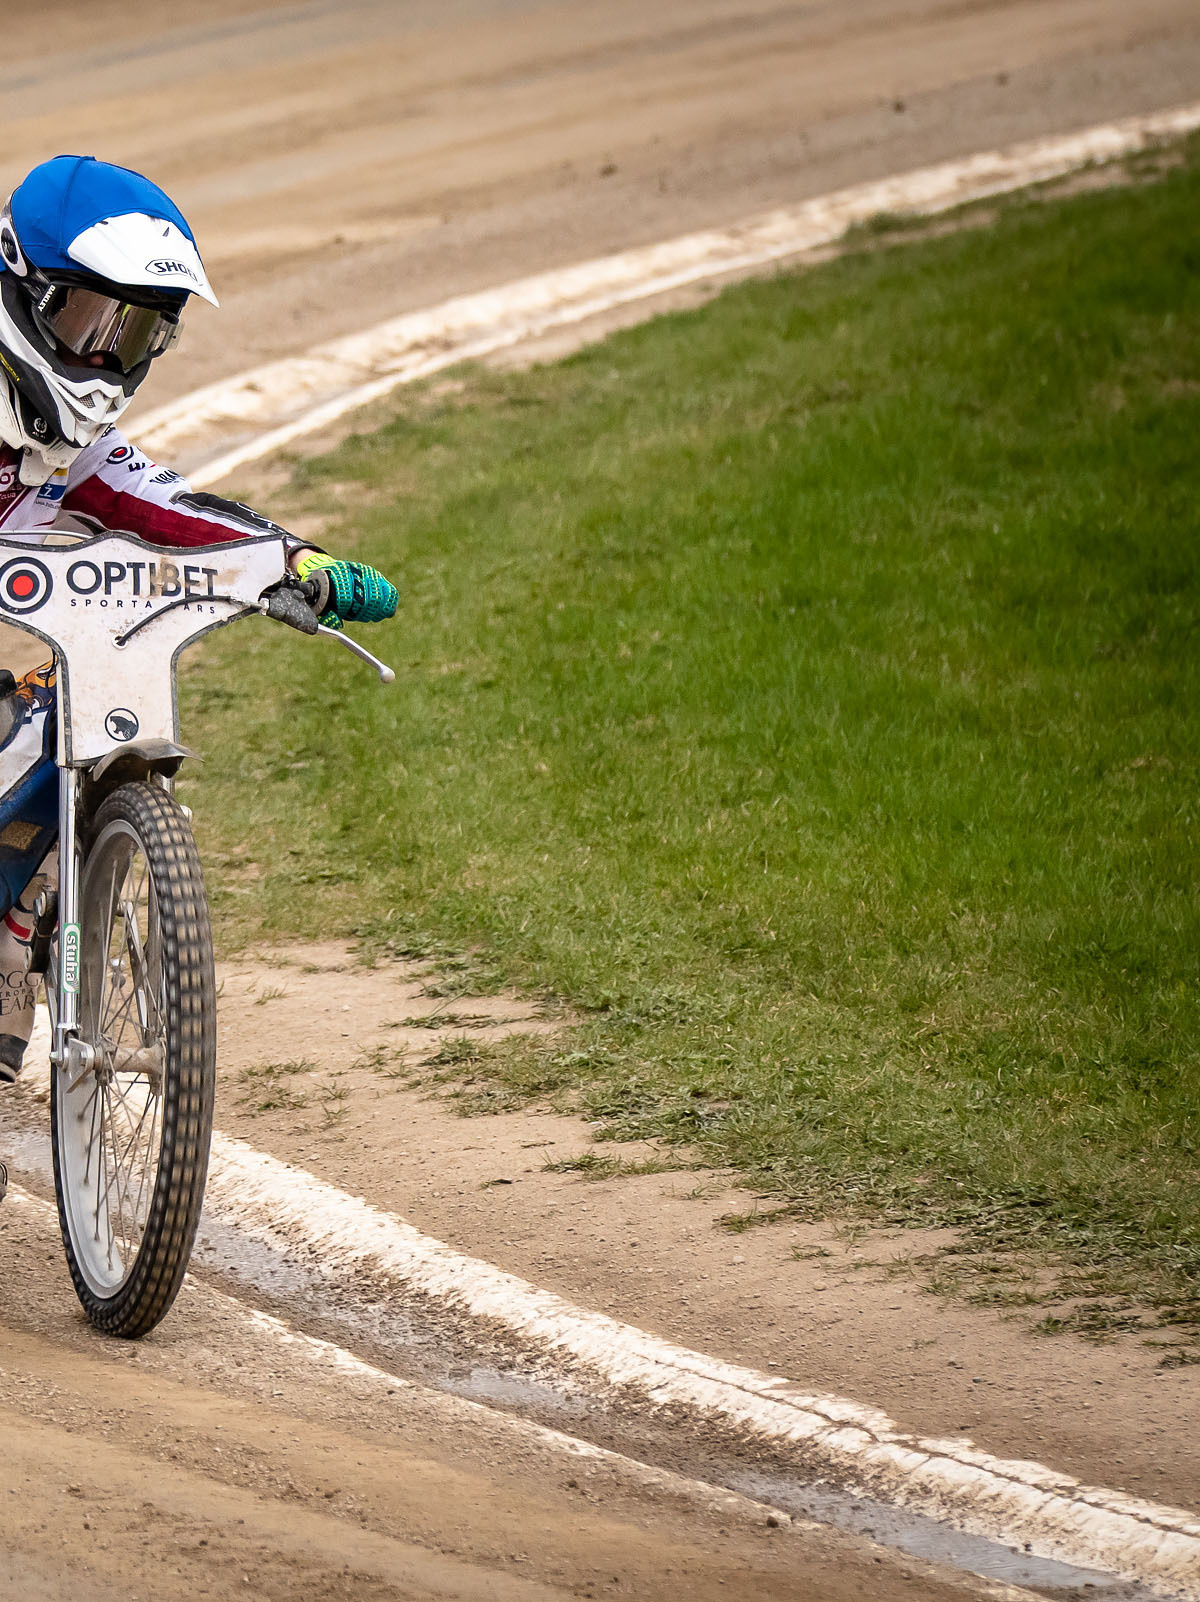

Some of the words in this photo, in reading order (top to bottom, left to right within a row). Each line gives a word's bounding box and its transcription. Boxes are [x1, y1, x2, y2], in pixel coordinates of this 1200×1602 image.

[37, 284, 57, 312] OAKLEY
[66, 560, 219, 598] OPTIBET
[70, 598, 153, 609] SPORTA
[66, 934, 80, 983] stuha
